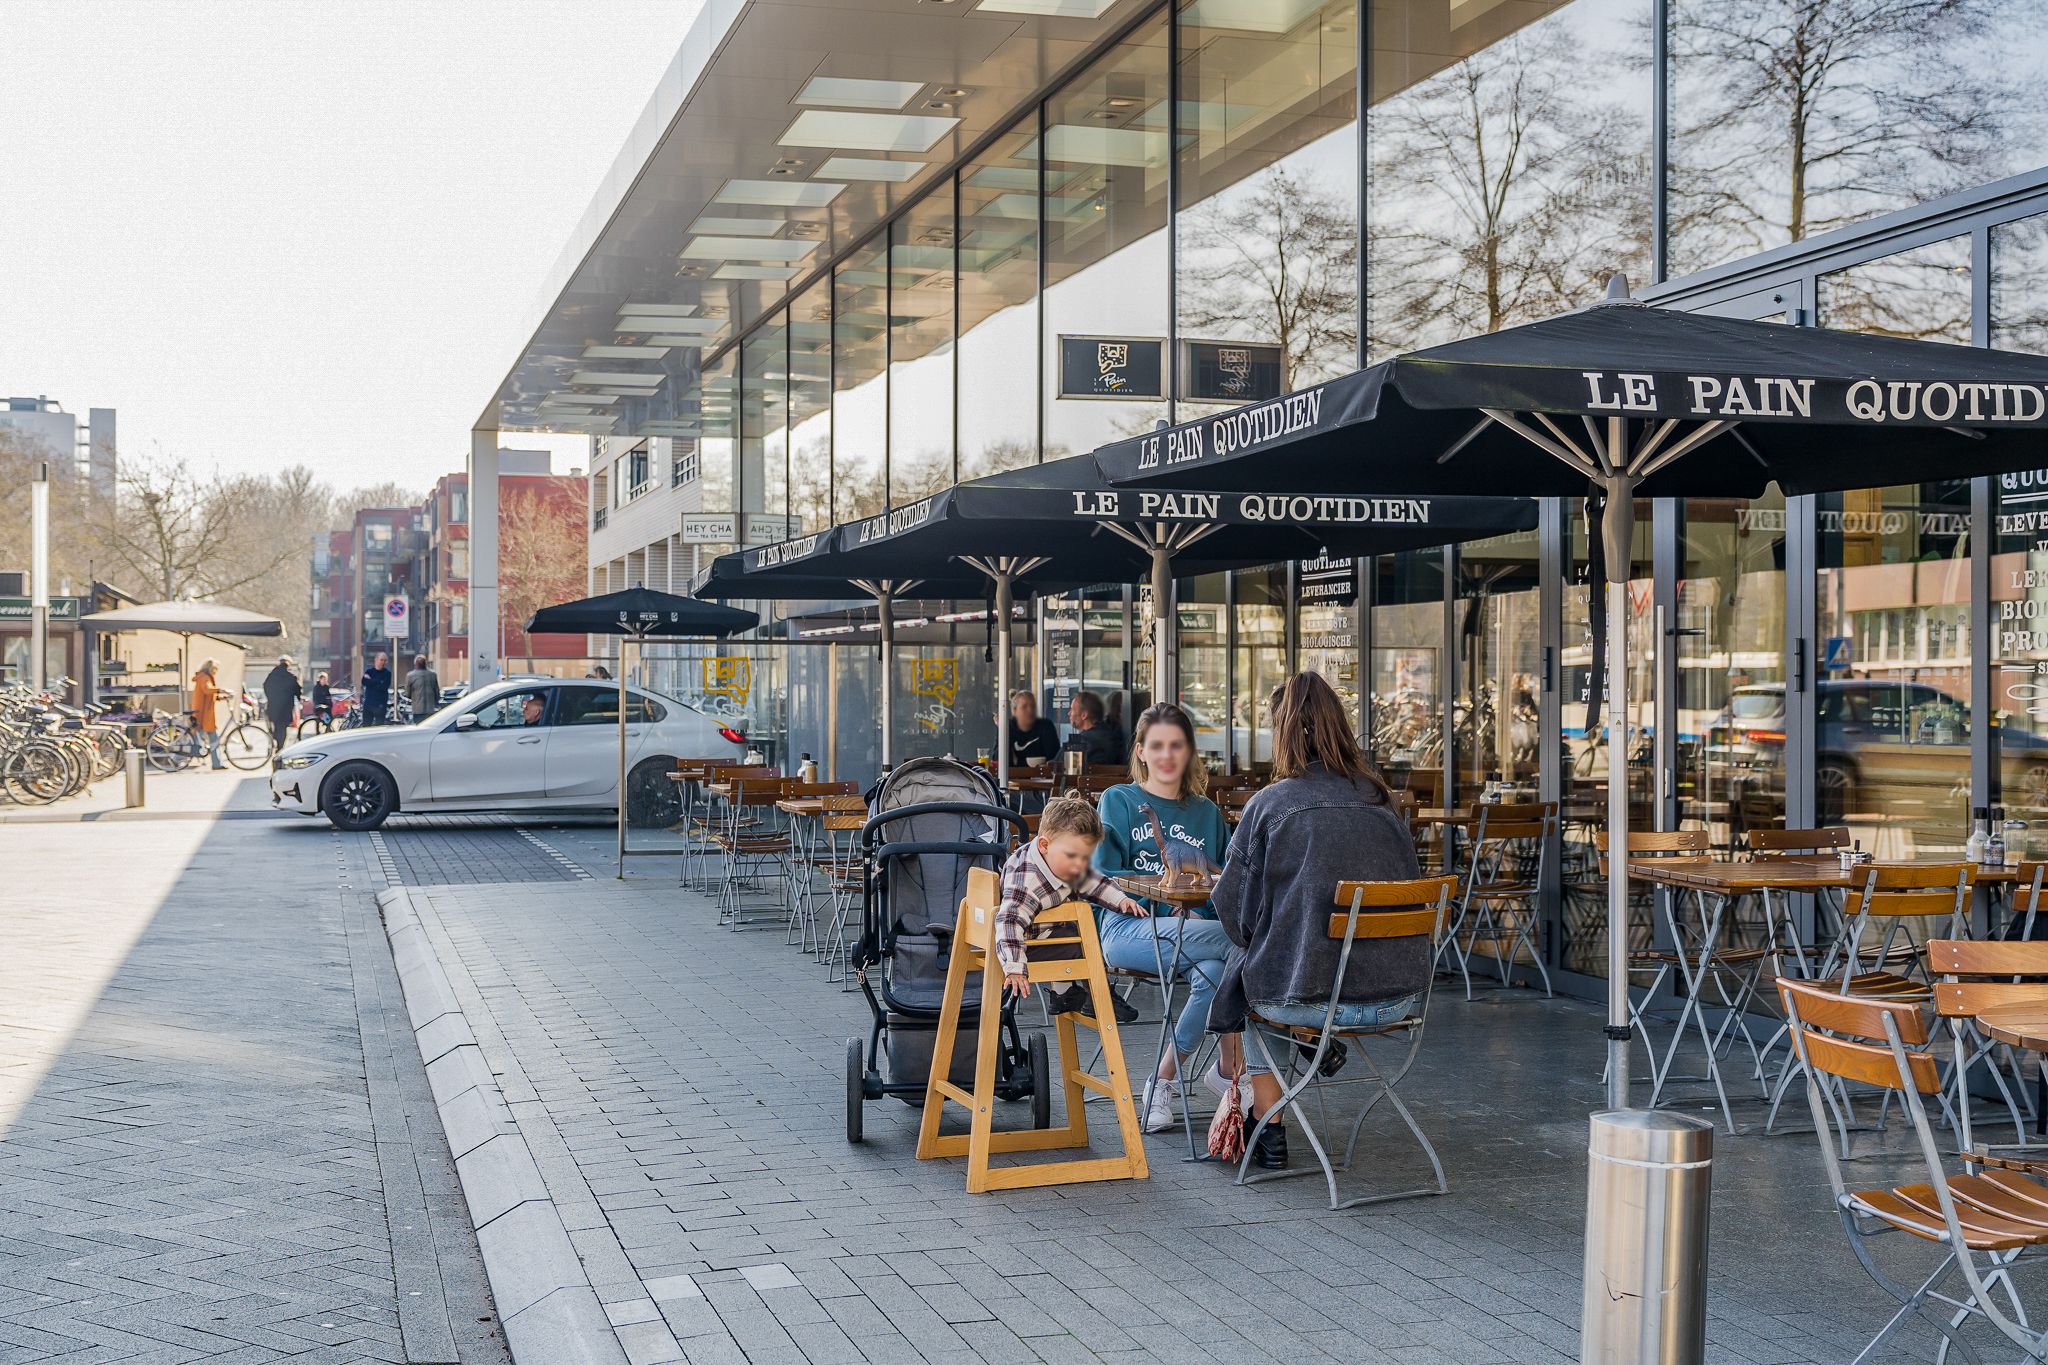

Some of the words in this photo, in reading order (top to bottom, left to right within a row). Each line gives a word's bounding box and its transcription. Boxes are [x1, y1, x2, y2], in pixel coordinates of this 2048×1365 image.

[1099, 372, 1127, 388] Pain
[1582, 372, 1657, 412] LE
[1687, 376, 1815, 418] PAIN
[1845, 380, 2048, 422] QUOTID
[1138, 437, 1160, 470] LE
[1166, 425, 1203, 465] PAIN
[1213, 387, 1325, 456] QUOTIDIEN
[859, 523, 871, 543] LE
[871, 515, 887, 540] PAIN
[889, 498, 932, 536] QUOTIDIEN
[1072, 491, 1119, 516] LE
[1139, 493, 1221, 518] PAIN
[1239, 495, 1431, 523] QUOTIDIEN
[686, 525, 707, 533] HEY
[710, 524, 732, 533] CHA
[766, 545, 781, 566] PAIN
[781, 535, 819, 563] QUOTIDIEN
[1302, 556, 1352, 573] QUOTIDIEN
[1302, 582, 1352, 597] LEVERANCIER
[1302, 634, 1351, 648] BIOLOGISCHE
[1169, 824, 1205, 851] Coast
